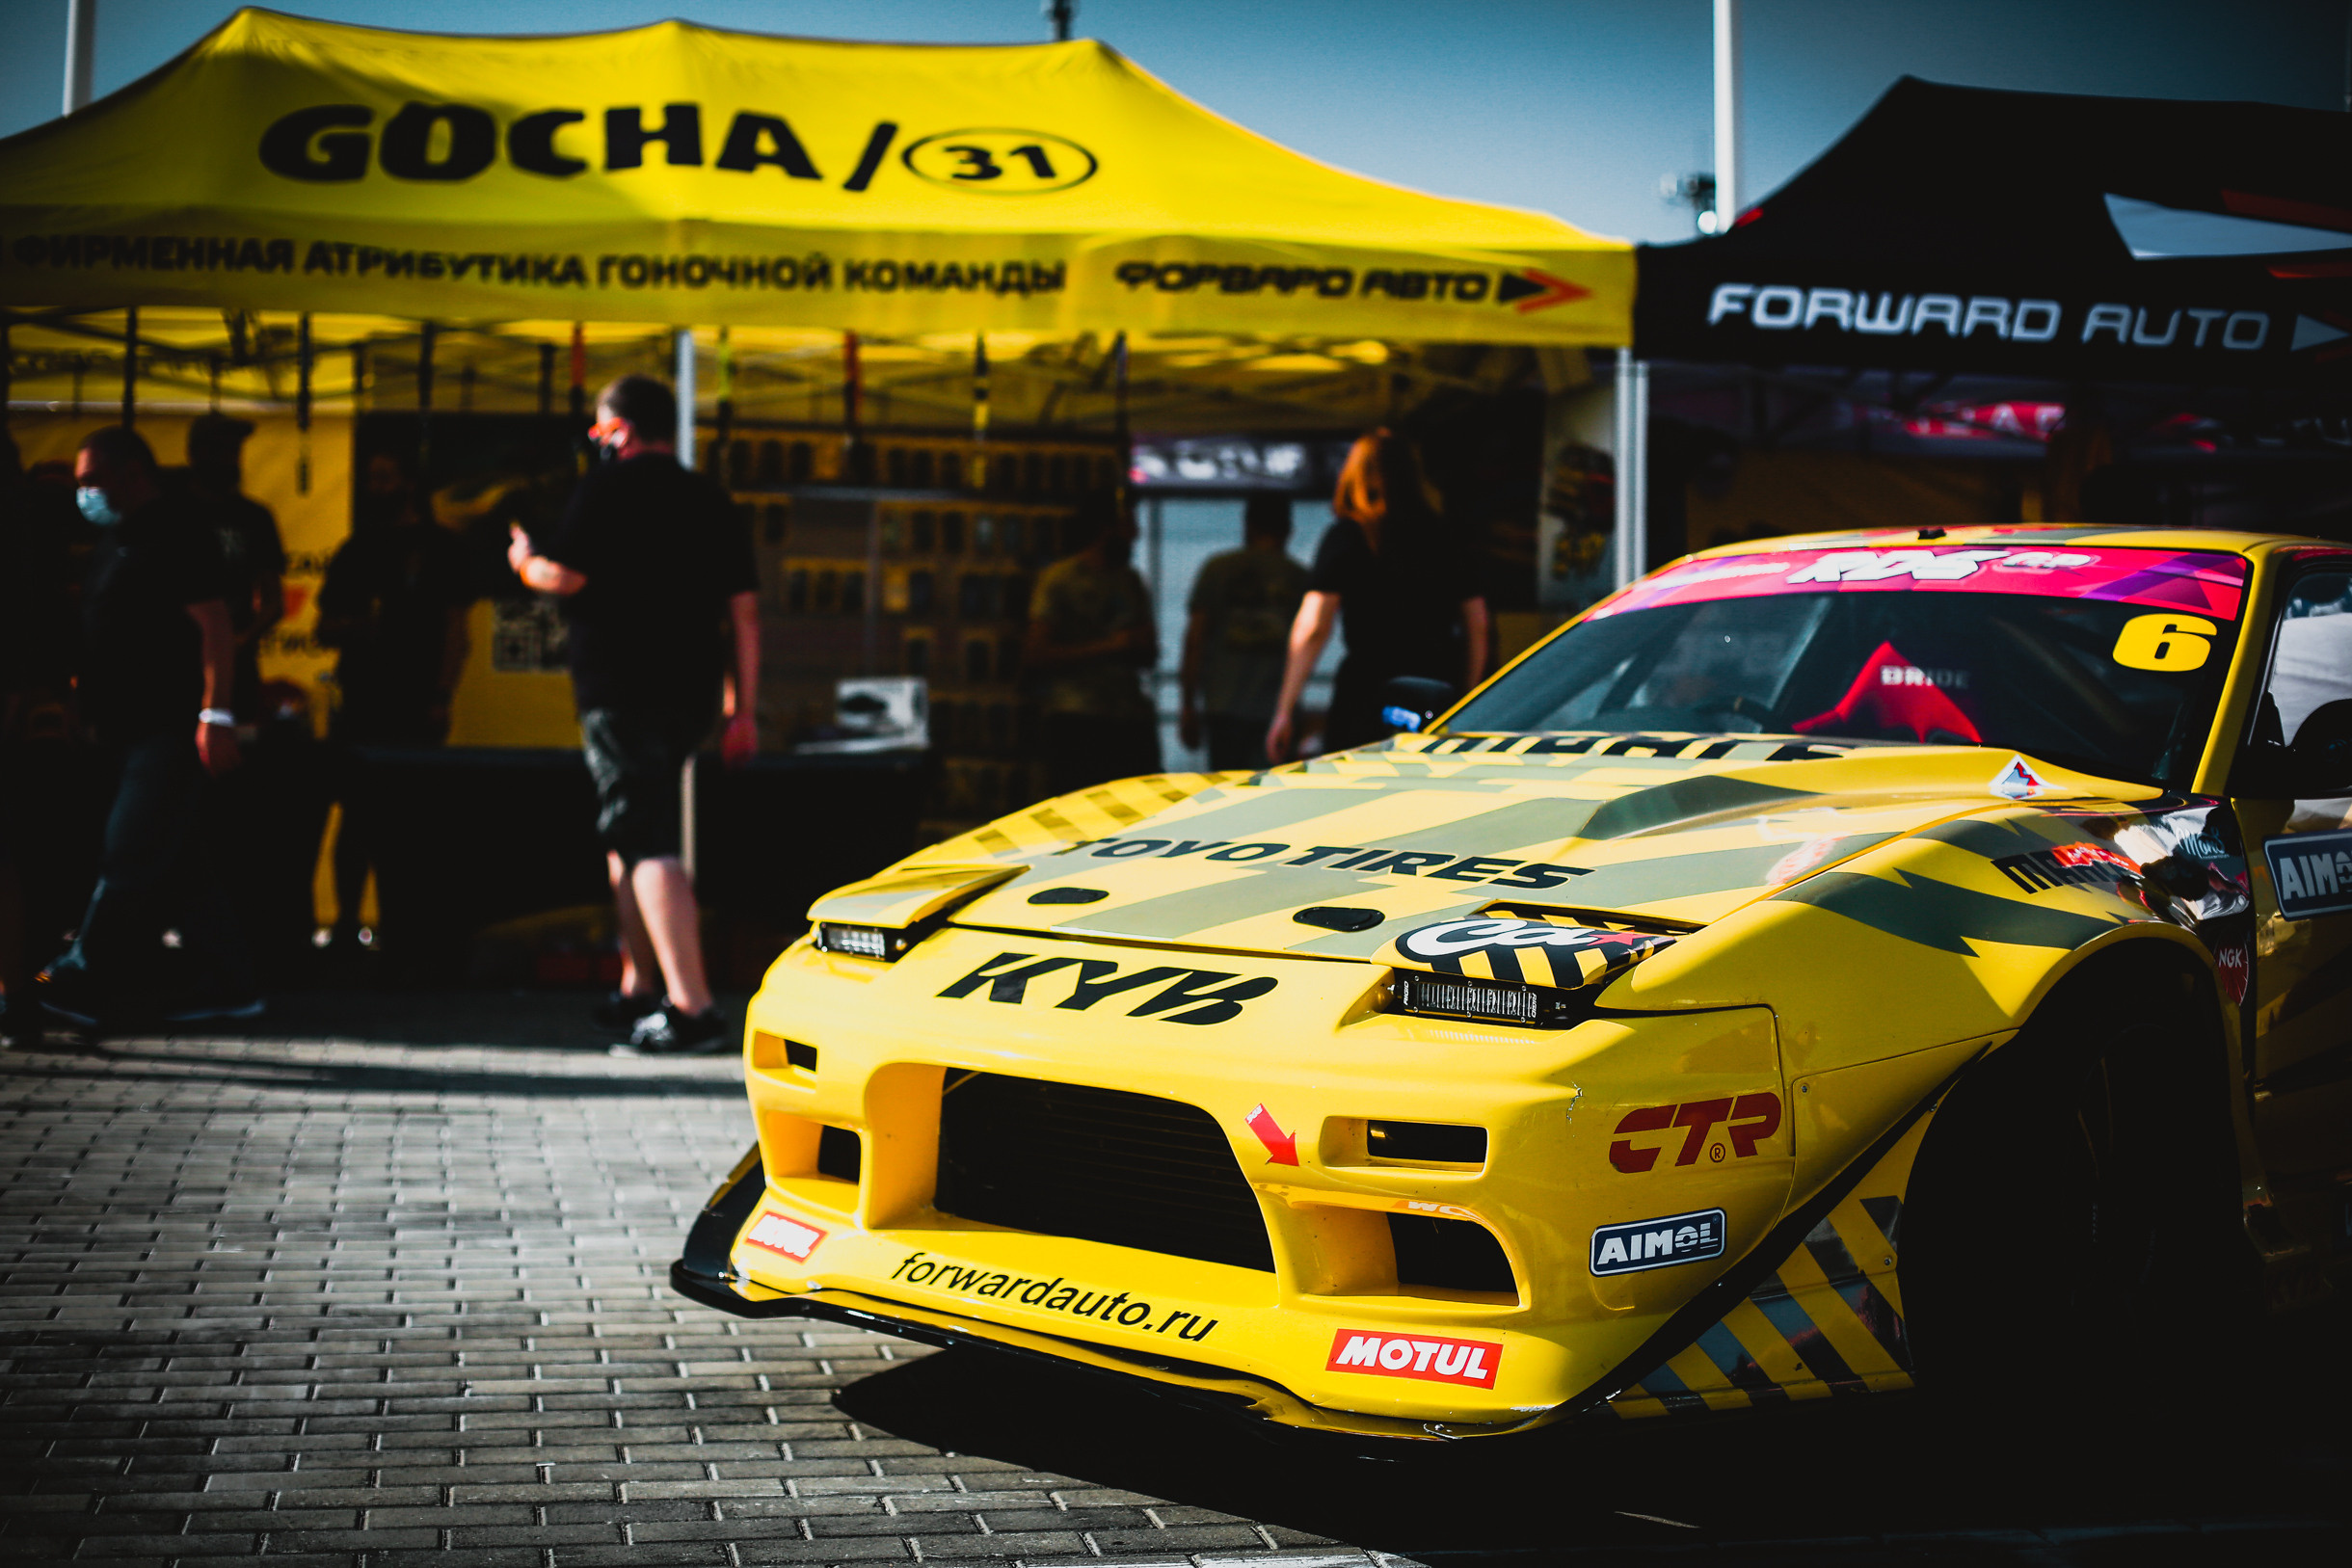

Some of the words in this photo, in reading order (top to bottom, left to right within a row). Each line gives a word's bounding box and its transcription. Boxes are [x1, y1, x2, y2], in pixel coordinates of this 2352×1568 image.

[258, 100, 822, 183] GOCHA
[940, 145, 1057, 181] 31
[13, 234, 295, 273] ФИРМЕННАЯ
[303, 240, 590, 289] АТРИБУТИКА
[598, 252, 833, 291] ГОНОЧНОЙ
[843, 259, 1067, 298] КОМАНДЫ
[1360, 269, 1490, 301] АВТО
[1708, 283, 2062, 342] FORWARD
[2082, 303, 2270, 351] AUTO
[2112, 613, 2219, 673] 6
[1048, 837, 1292, 862] TOYO
[1283, 845, 1596, 889] TIRES
[2279, 851, 2352, 900] AIMO
[2218, 947, 2242, 969] NGK
[935, 951, 1279, 1025] KYB
[1596, 1222, 1719, 1265] AIMOL
[890, 1252, 1218, 1342] forwardauto.ru
[1335, 1335, 1488, 1380] MOTUL
